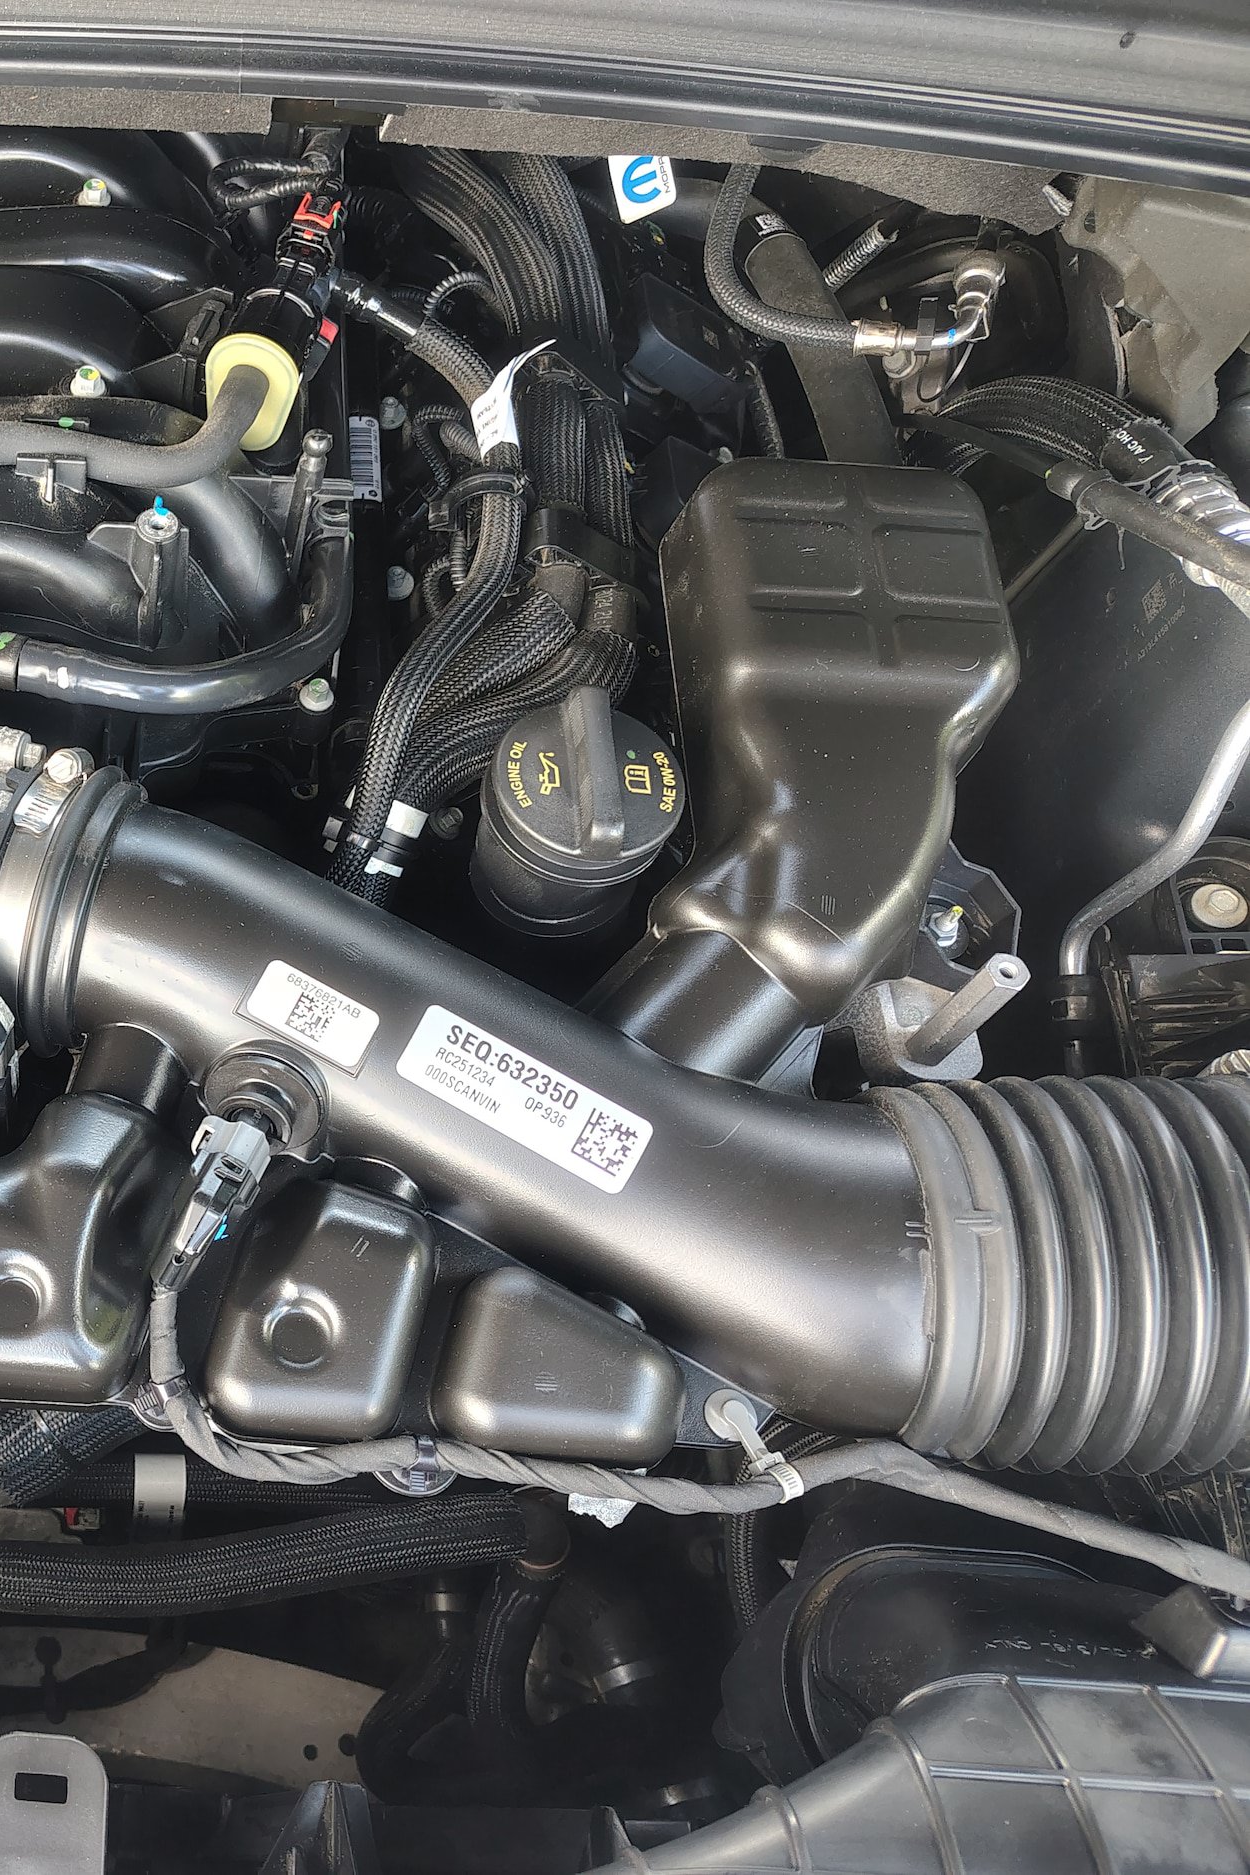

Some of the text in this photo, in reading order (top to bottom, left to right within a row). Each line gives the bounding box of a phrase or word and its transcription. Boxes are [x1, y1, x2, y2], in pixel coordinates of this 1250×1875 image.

[1116, 428, 1134, 444] HO
[507, 740, 533, 808] ENGINE OIL
[652, 751, 677, 813] SAE 0W-20
[286, 972, 361, 1018] 68376821AB
[424, 1064, 501, 1113] 000SCANVIN
[434, 1047, 495, 1088] RC251234
[445, 1024, 579, 1110] SEQ:632350
